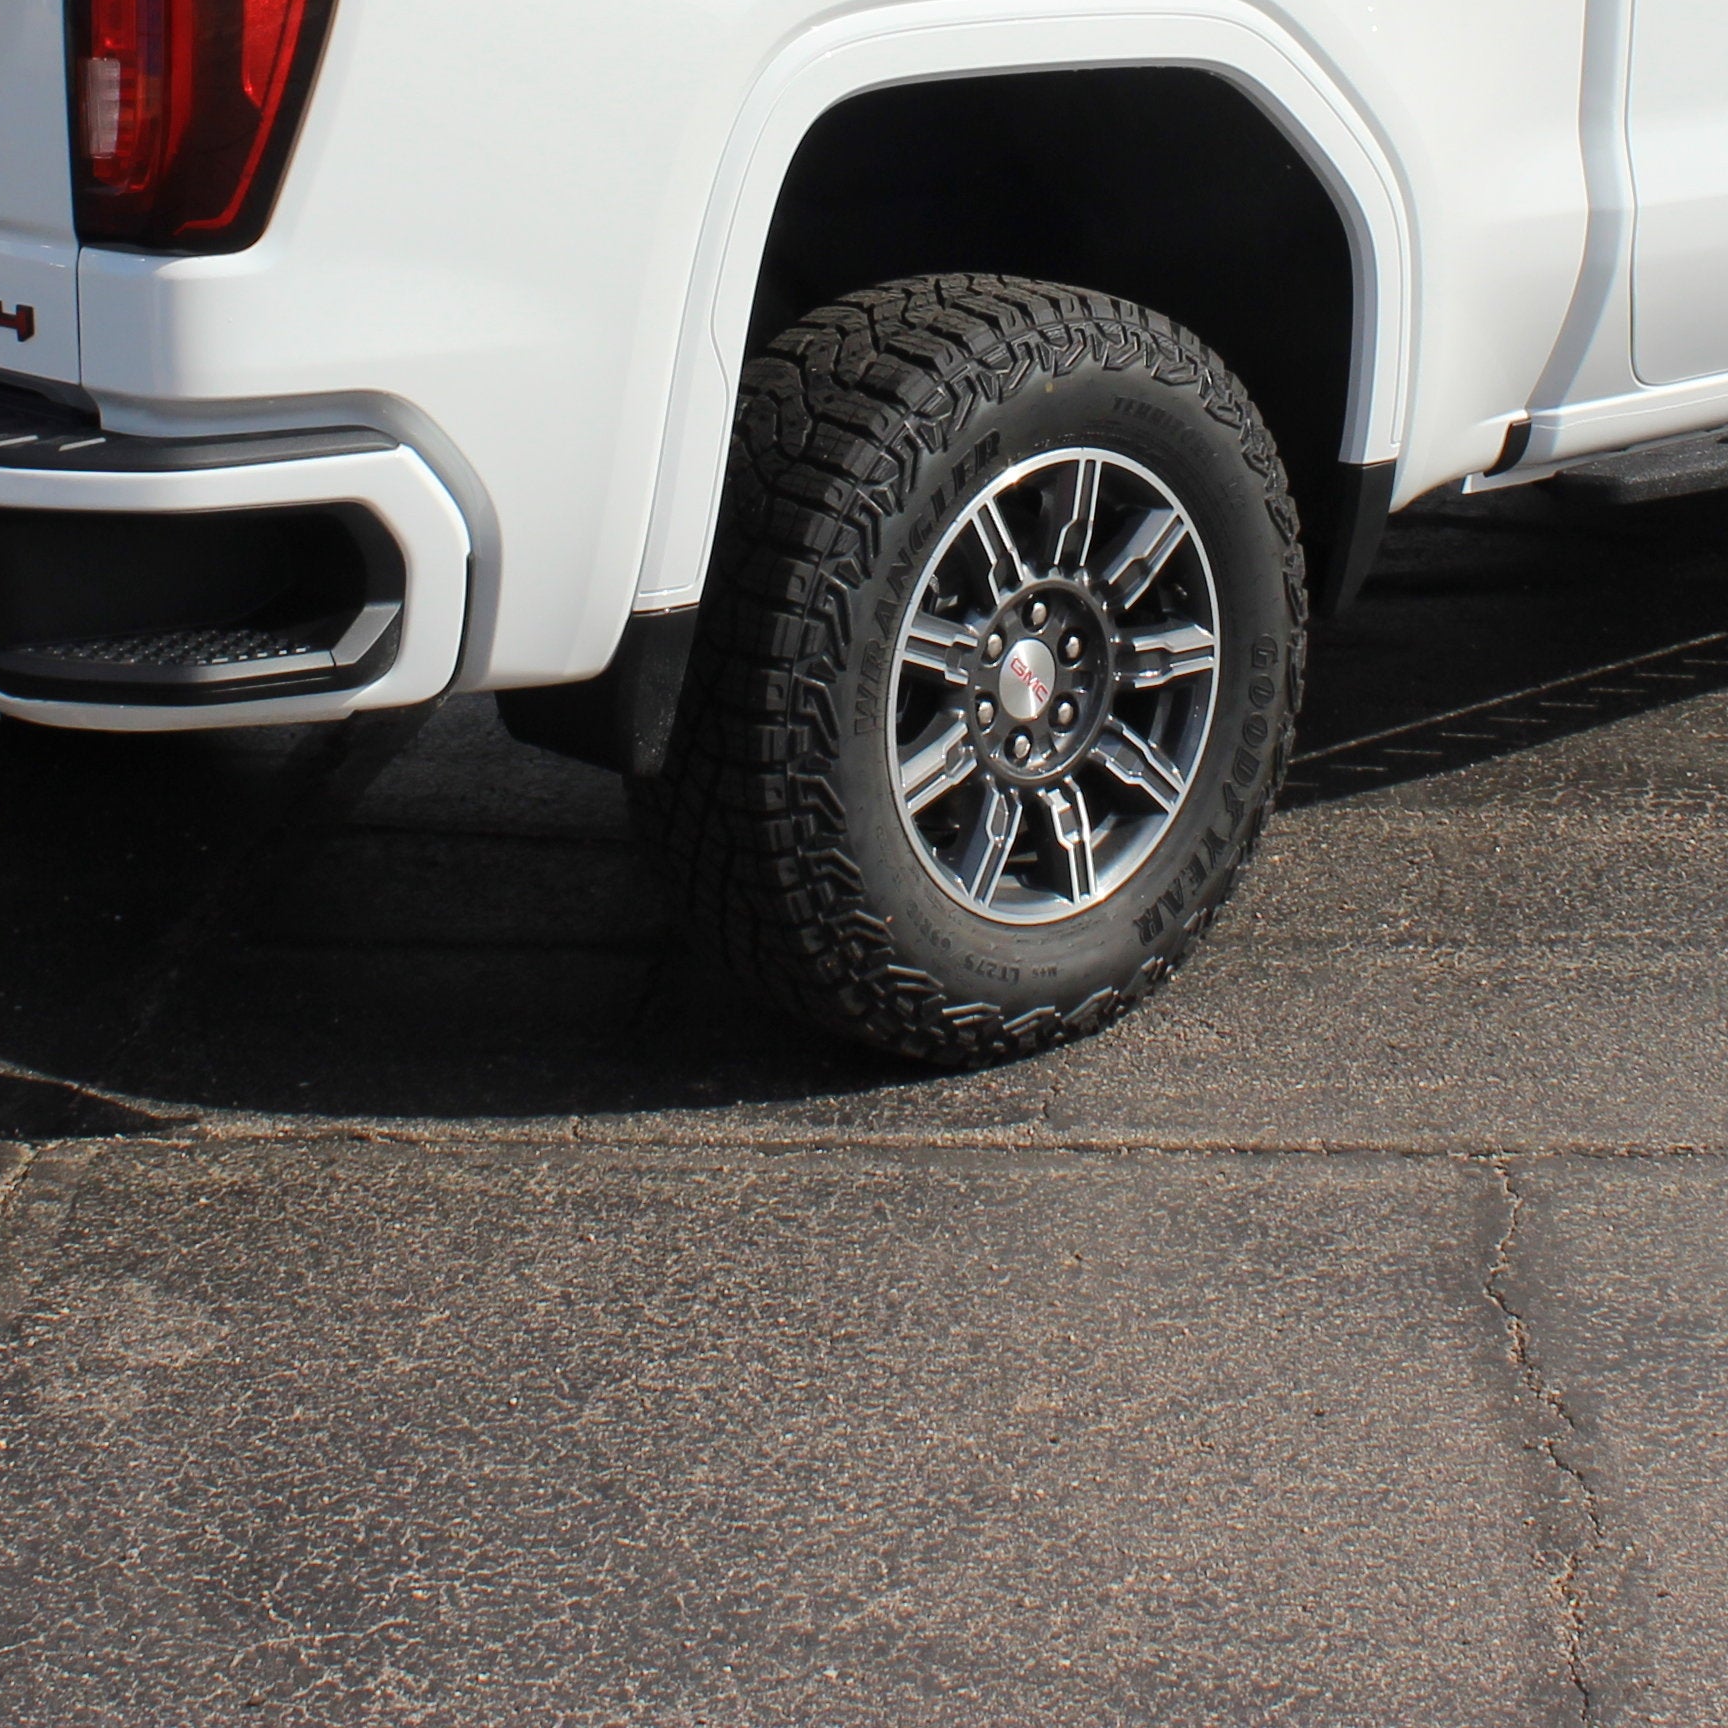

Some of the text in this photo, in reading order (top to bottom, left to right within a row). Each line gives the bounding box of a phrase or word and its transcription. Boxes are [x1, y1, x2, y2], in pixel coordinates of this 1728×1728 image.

[854, 428, 1001, 736] WRANGLER
[1010, 657, 1049, 703] GMC
[1133, 634, 1278, 947] GOODYEAR
